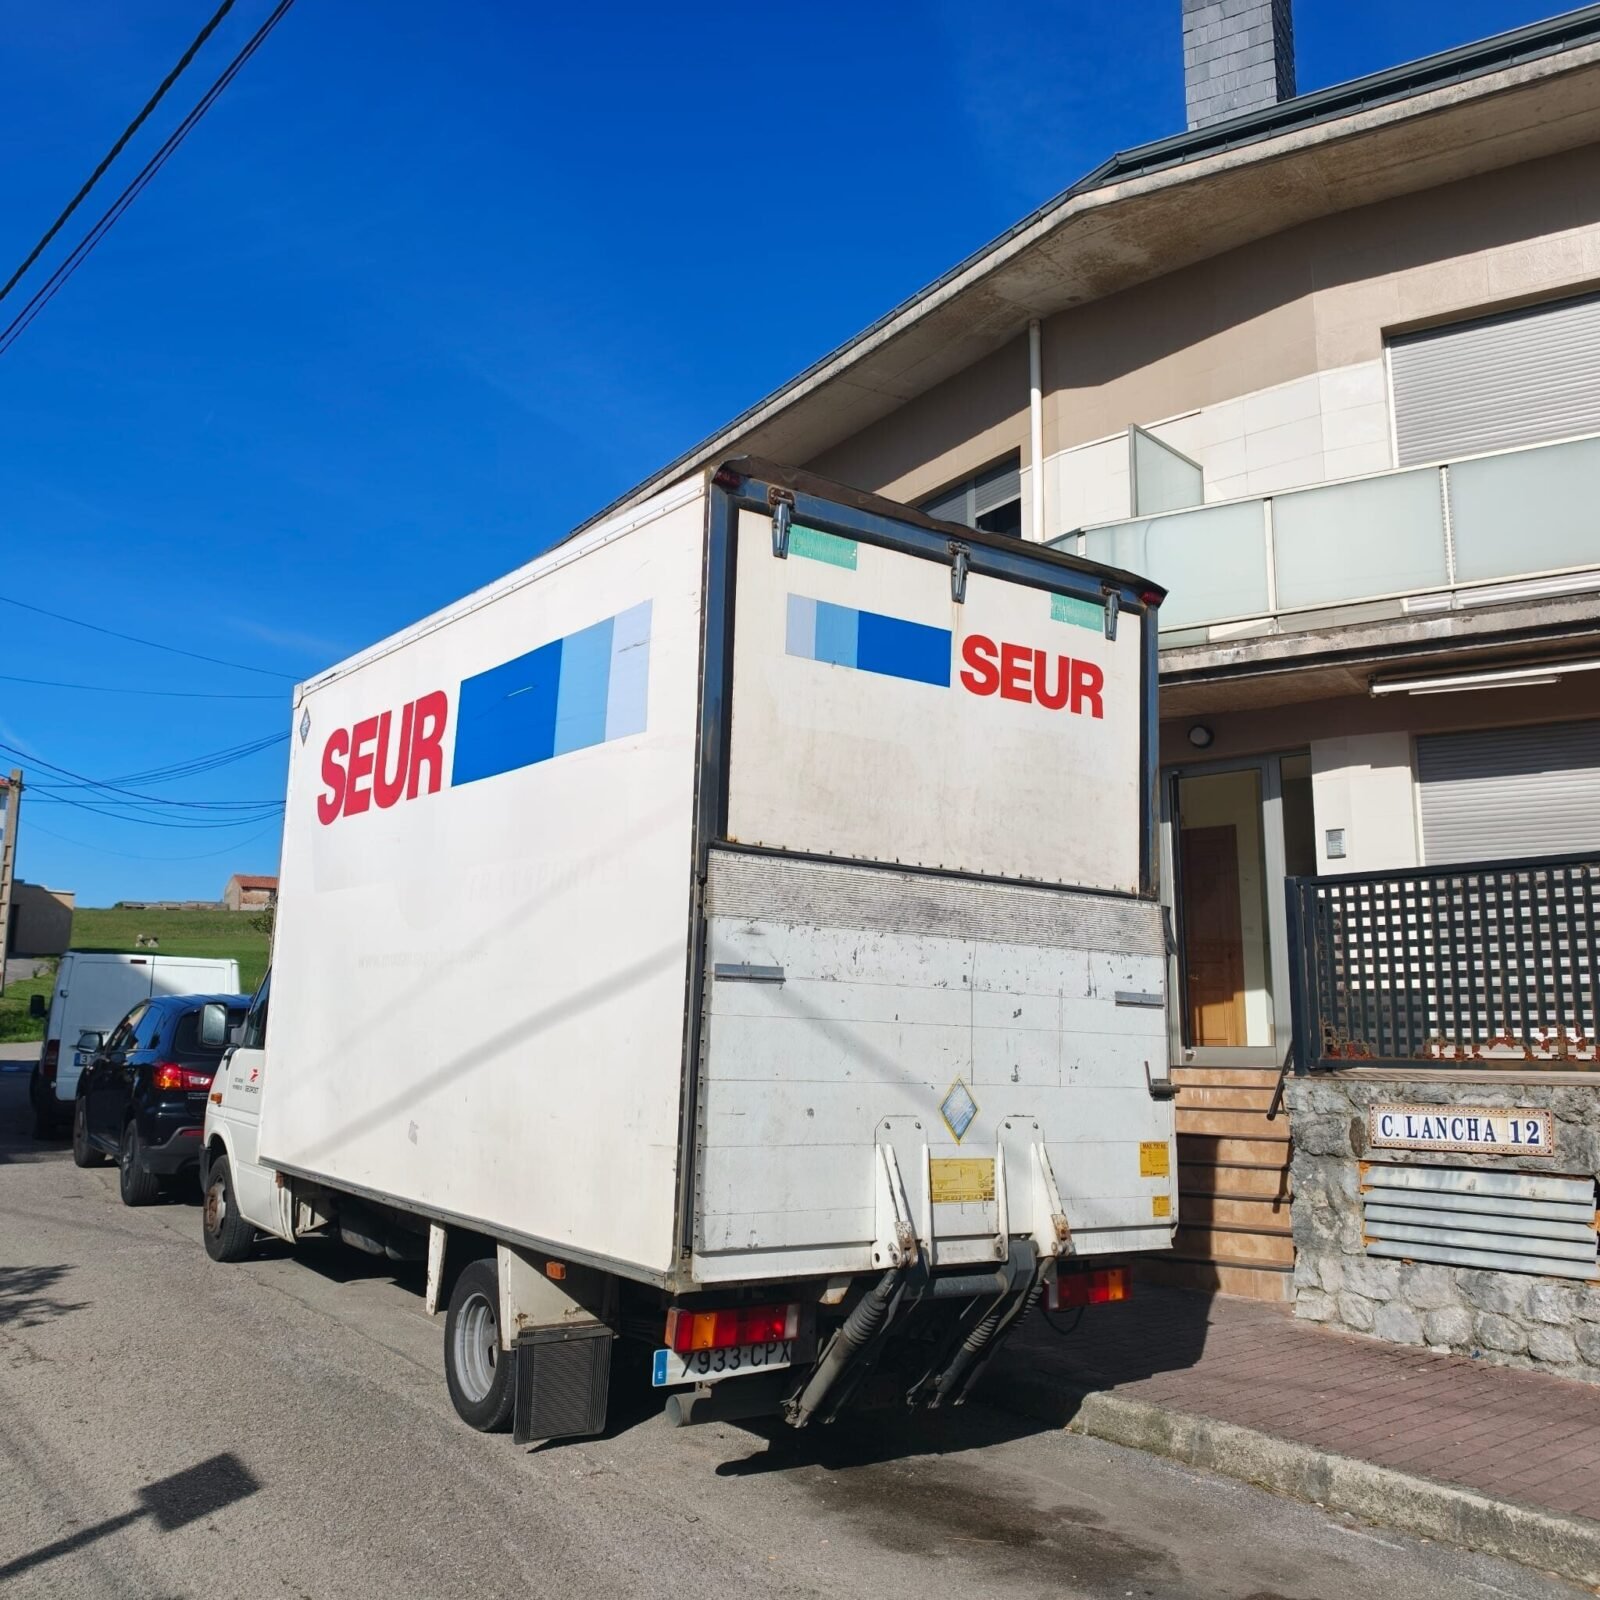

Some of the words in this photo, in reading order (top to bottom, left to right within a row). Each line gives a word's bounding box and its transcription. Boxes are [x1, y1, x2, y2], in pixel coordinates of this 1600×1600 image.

[960, 634, 1104, 719] SEUR
[317, 690, 448, 825] SEUR
[1381, 1115, 1400, 1138] C.
[1406, 1116, 1497, 1142] LANCHA
[1510, 1120, 1540, 1144] 12
[657, 1371, 663, 1379] E
[681, 1347, 741, 1378] 7933
[751, 1342, 791, 1367] CPX
